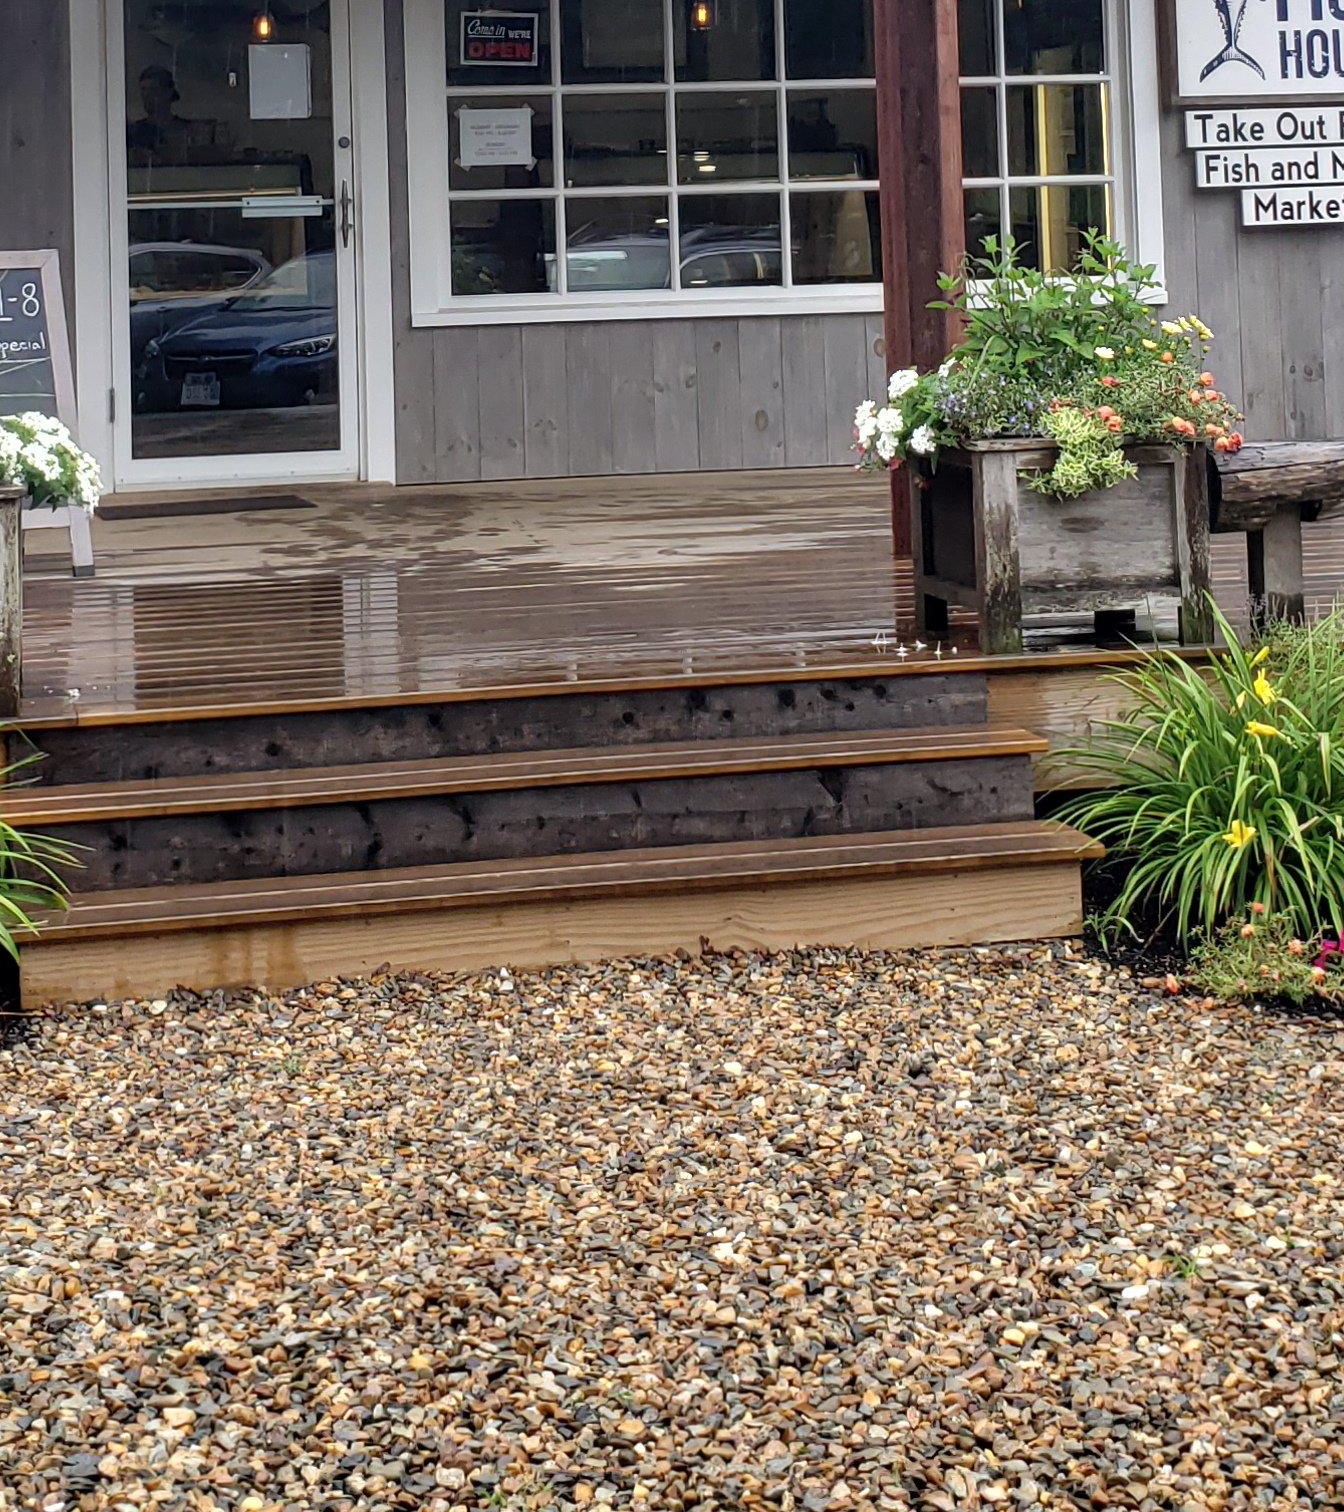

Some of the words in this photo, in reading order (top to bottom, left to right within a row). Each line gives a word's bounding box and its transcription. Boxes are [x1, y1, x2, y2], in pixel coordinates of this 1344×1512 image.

[495, 24, 506, 36] in
[468, 41, 532, 59] OPEN
[1193, 113, 1264, 143] Take
[1275, 111, 1328, 142] Out
[1204, 153, 1260, 184] Fish
[1271, 152, 1319, 181] and
